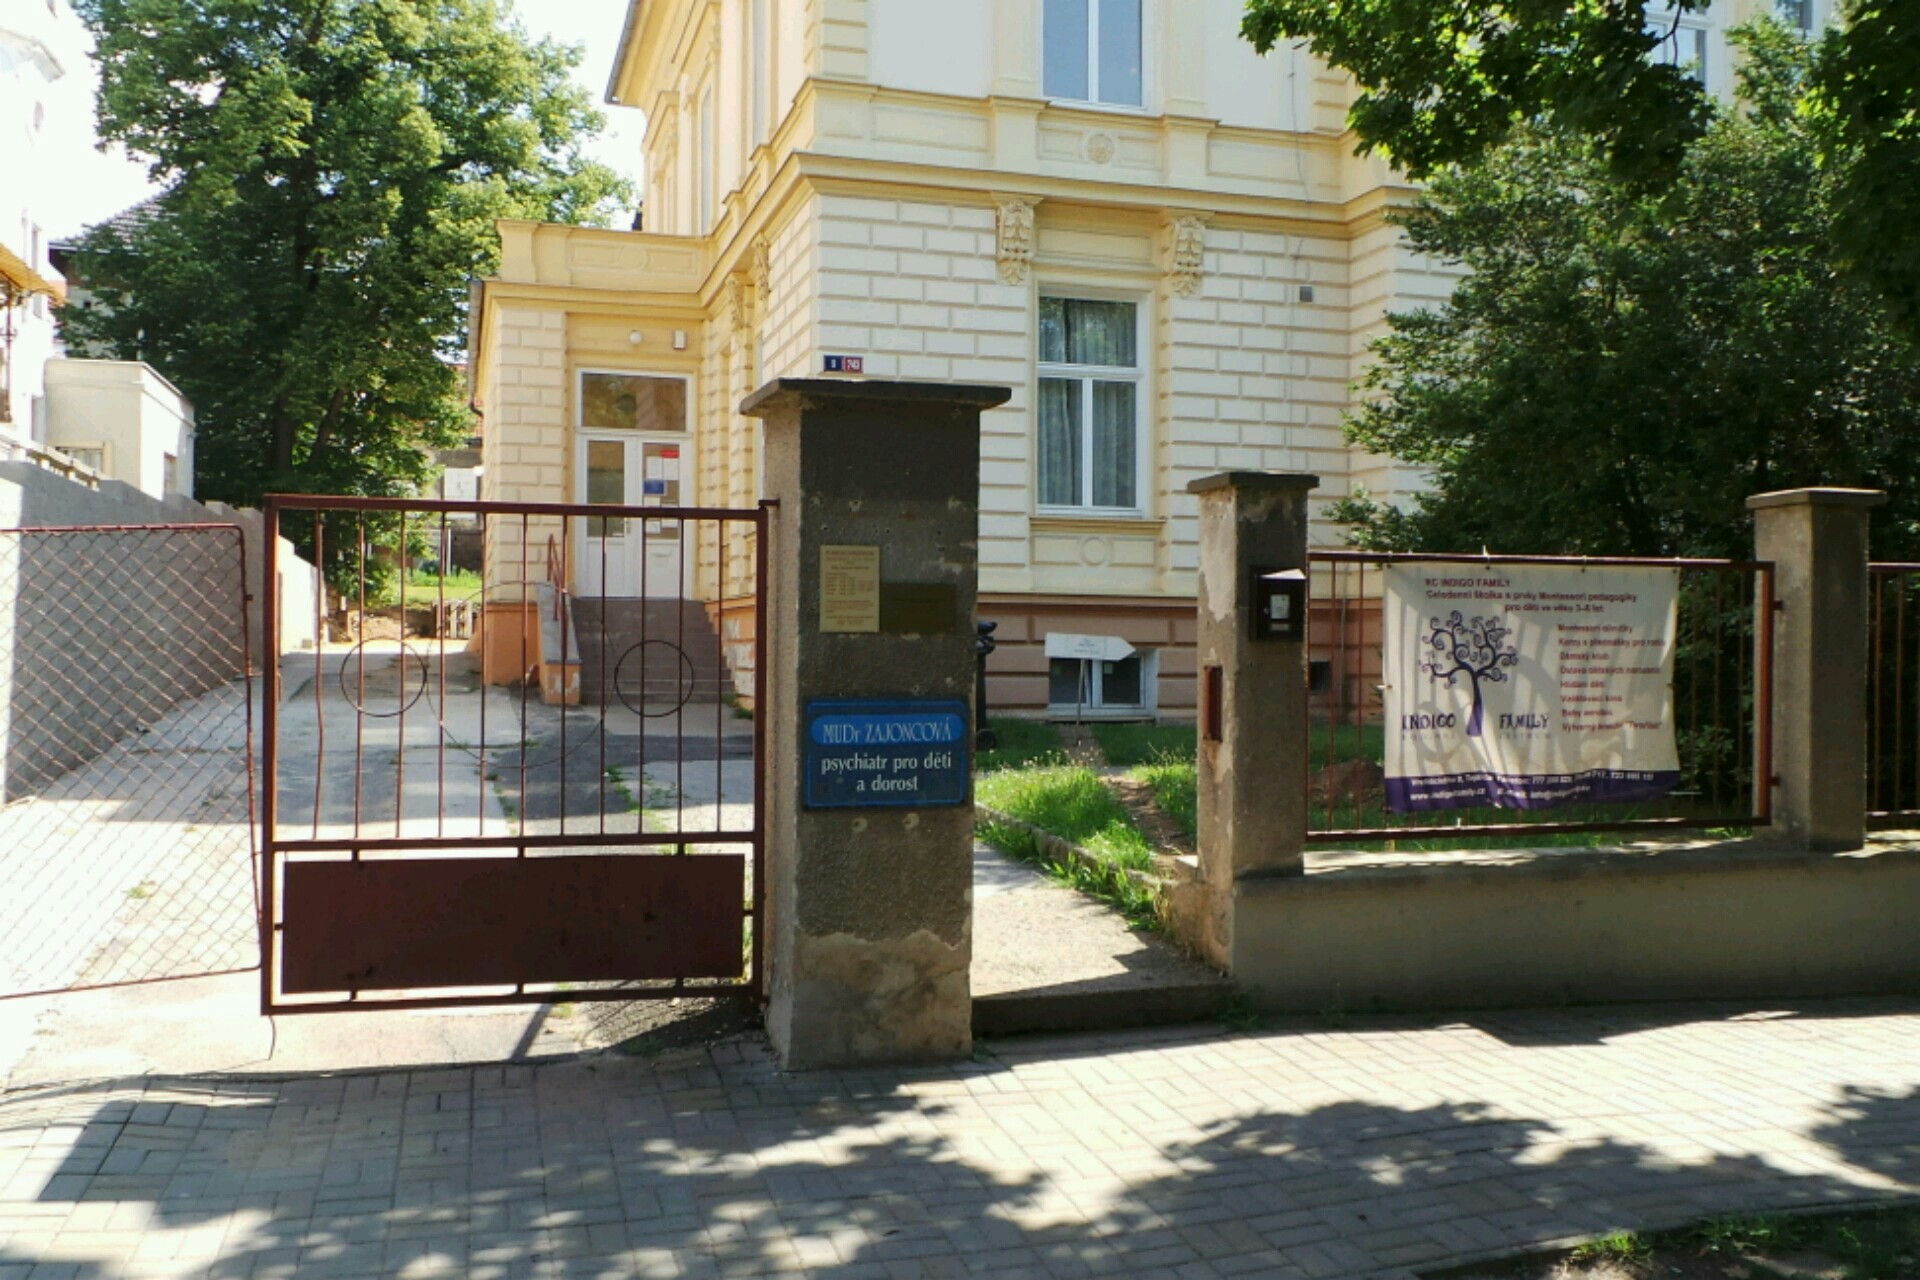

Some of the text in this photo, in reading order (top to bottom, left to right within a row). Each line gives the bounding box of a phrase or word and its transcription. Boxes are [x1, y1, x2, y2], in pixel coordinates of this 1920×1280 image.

[1440, 578, 1474, 587] INDIGO
[1476, 578, 1511, 587] FAMILY
[1538, 592, 1586, 601] Montessori
[1588, 593, 1637, 603] pedagogiky
[1504, 604, 1521, 613] pro
[1592, 604, 1604, 613] let
[864, 716, 952, 743] ZAJONCOVÁ
[1402, 713, 1456, 729] INDIGO
[1499, 712, 1549, 730] FAMILY
[821, 750, 952, 775] psychiatr pro děti
[856, 774, 918, 792] a dorost
